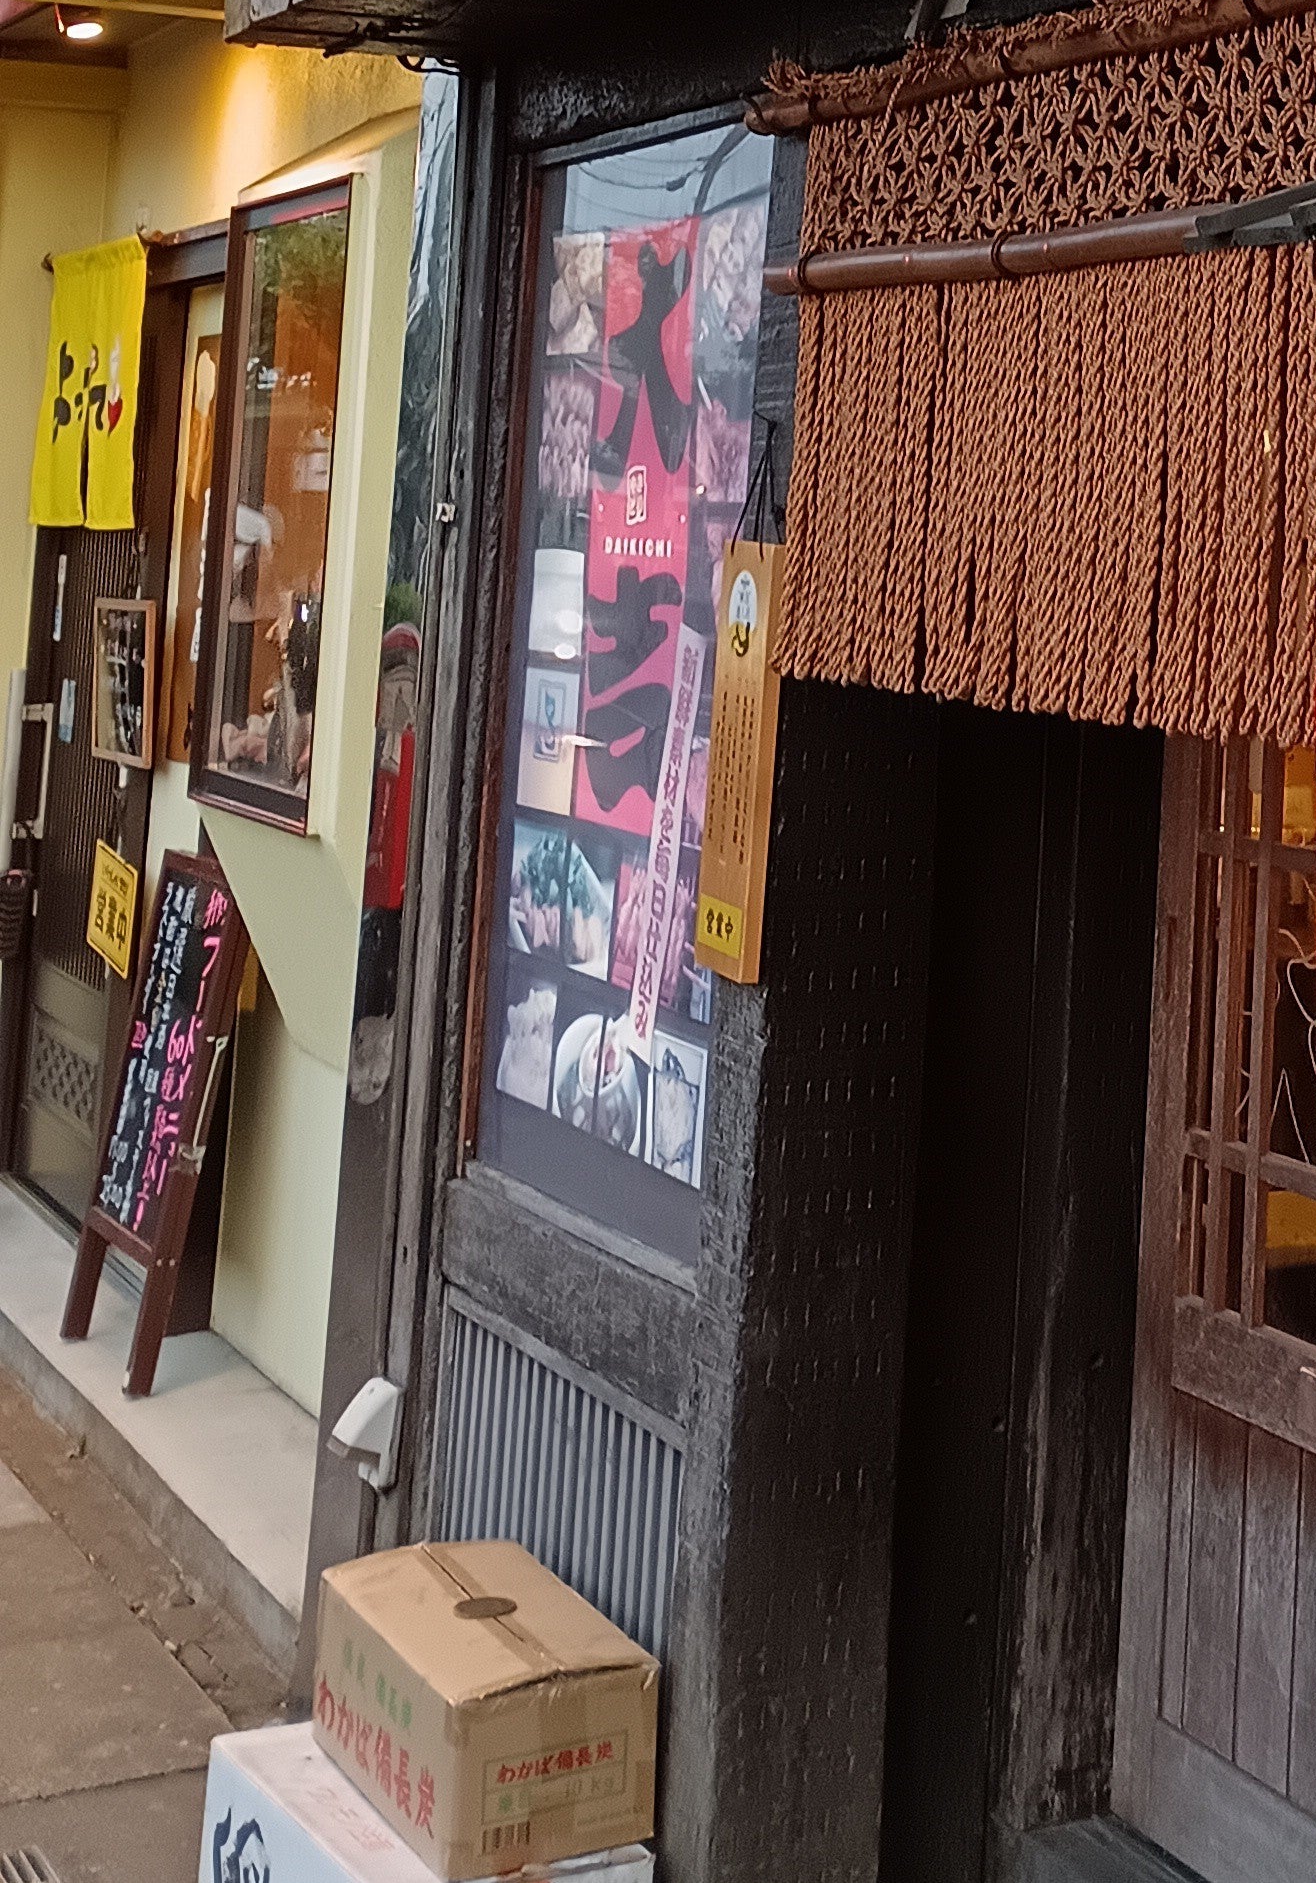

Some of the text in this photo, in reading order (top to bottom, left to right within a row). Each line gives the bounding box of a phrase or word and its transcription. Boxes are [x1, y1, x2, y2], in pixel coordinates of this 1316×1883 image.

[604, 536, 672, 557] DAIKICHI
[317, 1669, 435, 1840] わかば備長炭
[497, 1741, 613, 1784] わかば備長炭
